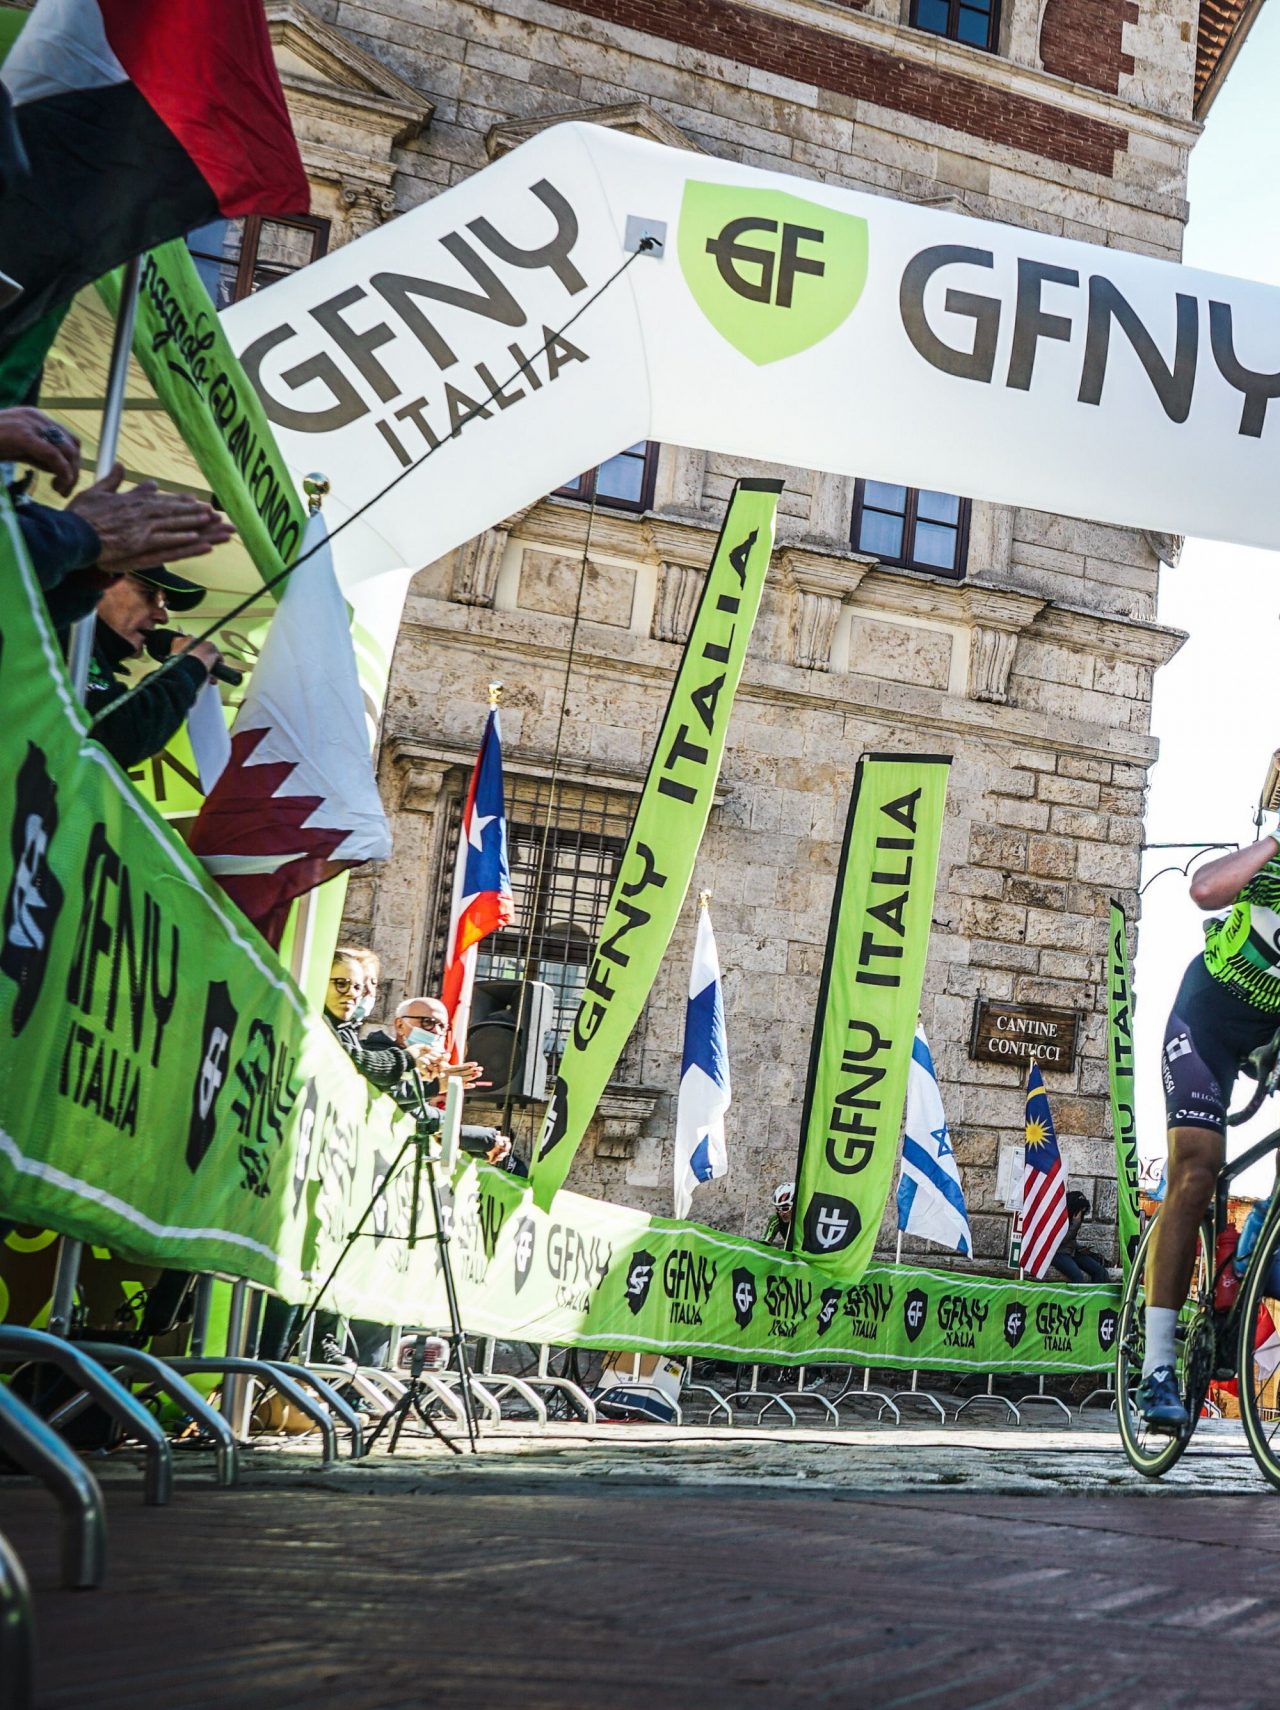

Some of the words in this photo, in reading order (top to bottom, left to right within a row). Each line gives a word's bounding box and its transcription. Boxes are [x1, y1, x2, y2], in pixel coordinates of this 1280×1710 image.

[705, 216, 825, 309] GF
[240, 178, 589, 433] GFNY
[375, 324, 591, 467] ITALIA
[574, 840, 668, 1052] GFNY
[657, 526, 760, 805] ITALIA
[855, 787, 922, 987] ITALIA
[67, 821, 179, 1069] GFNY
[1225, 909, 1244, 944] ITALIA
[996, 1015, 1058, 1038] CANTINE
[1112, 928, 1134, 1077] ITALIA
[58, 1020, 141, 1137] ITALIA
[825, 1019, 893, 1175] GFNY
[547, 1223, 613, 1290] GFNY
[663, 1249, 717, 1304] GFNY
[670, 1301, 703, 1325] ITALIA
[764, 1274, 813, 1321] GFNY
[852, 1319, 878, 1341] ITALIA
[937, 1295, 990, 1333] GFNY
[1035, 1301, 1084, 1337] GFNY
[1043, 1335, 1073, 1352] ITALIA
